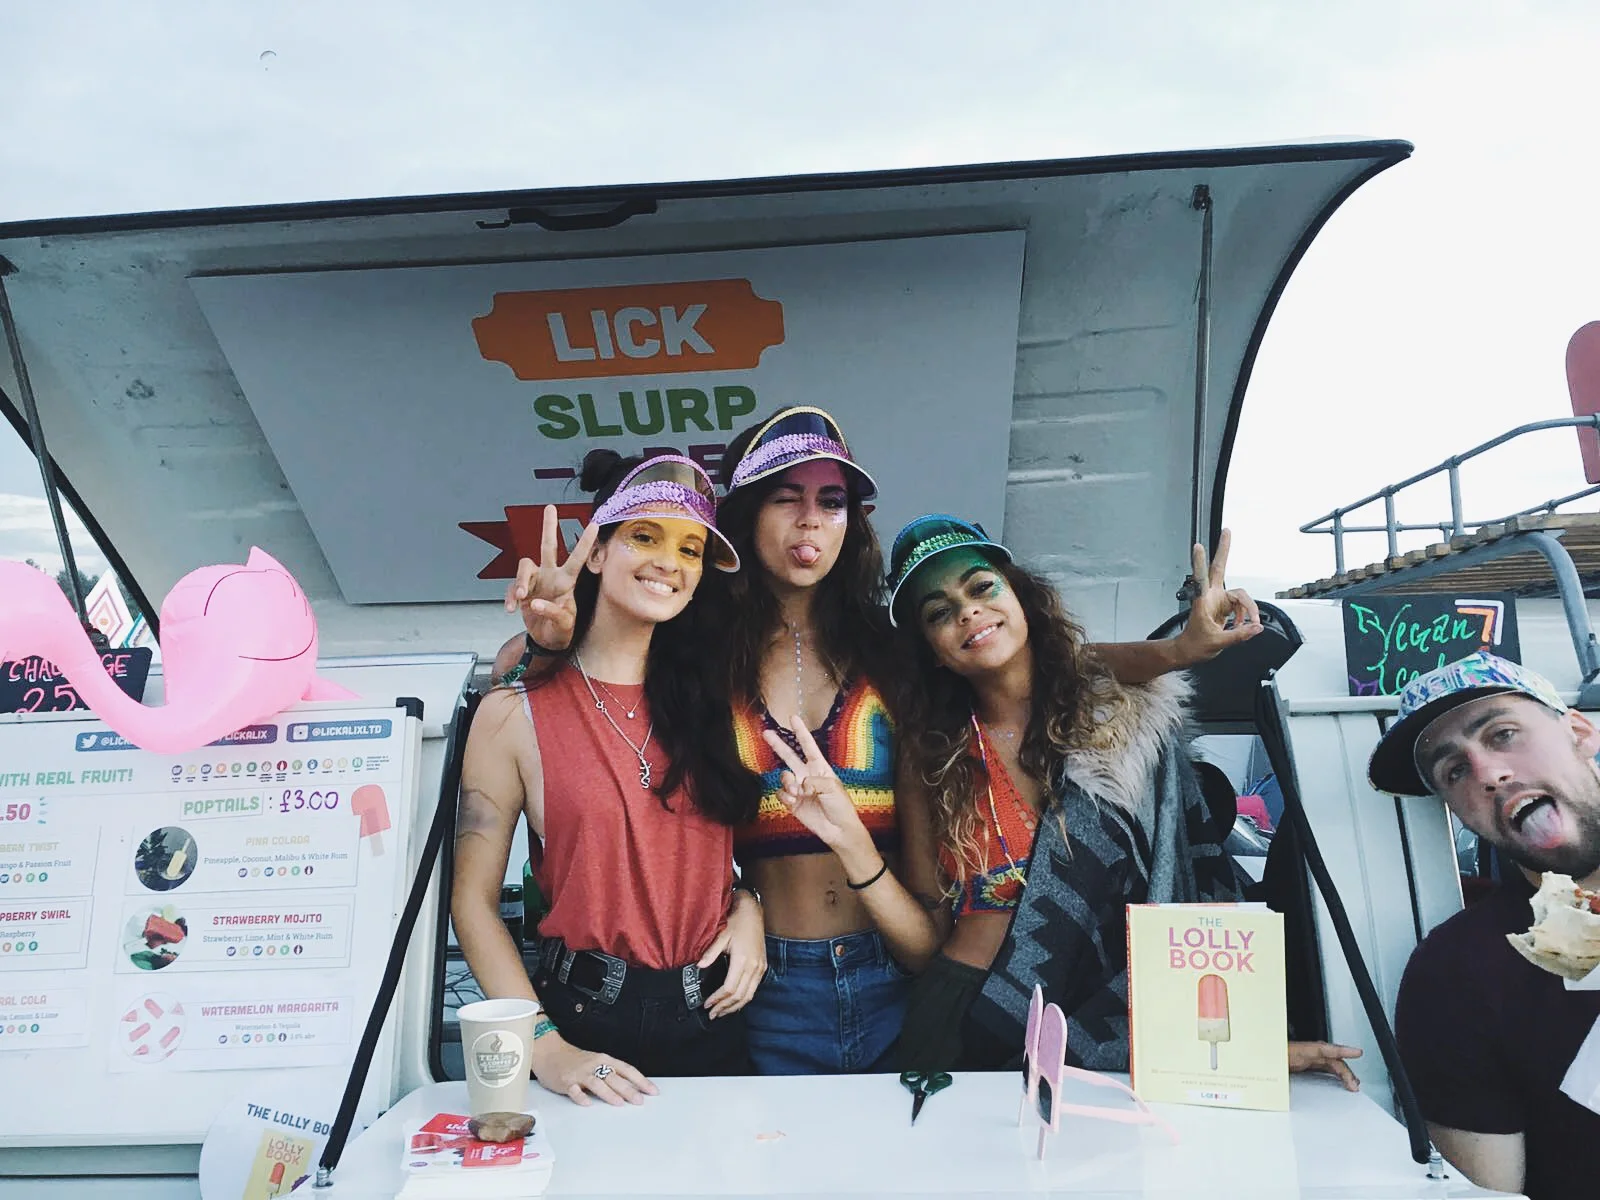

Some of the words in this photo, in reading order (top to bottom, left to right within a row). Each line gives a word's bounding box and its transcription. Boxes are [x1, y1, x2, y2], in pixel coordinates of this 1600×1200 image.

[547, 304, 716, 362] LICK
[533, 385, 757, 440] SLURP
[1350, 603, 1476, 657] Vegan
[9, 654, 132, 679] CHALGE
[312, 724, 382, 737] @LICKALIXLTD
[35, 771, 75, 786] REAL
[81, 768, 133, 784] FRUIT!
[184, 796, 260, 816] POPTAILS
[280, 789, 339, 813] £3.00
[272, 835, 310, 846] COLADA
[41, 909, 71, 920] SWIRL
[213, 914, 280, 926] STRAWBERRY
[284, 913, 323, 924] MOJITO
[1197, 917, 1223, 928] THE
[1168, 926, 1255, 950] LOLLY
[1169, 949, 1256, 973] BOOK
[20, 994, 47, 1006] COLA
[201, 1004, 273, 1017] WATERMELON
[277, 1001, 340, 1014] MARGARITA
[247, 1103, 272, 1120] THE
[273, 1110, 311, 1130] LOLLY
[312, 1120, 333, 1136] BO
[268, 1138, 305, 1156] LOLLY
